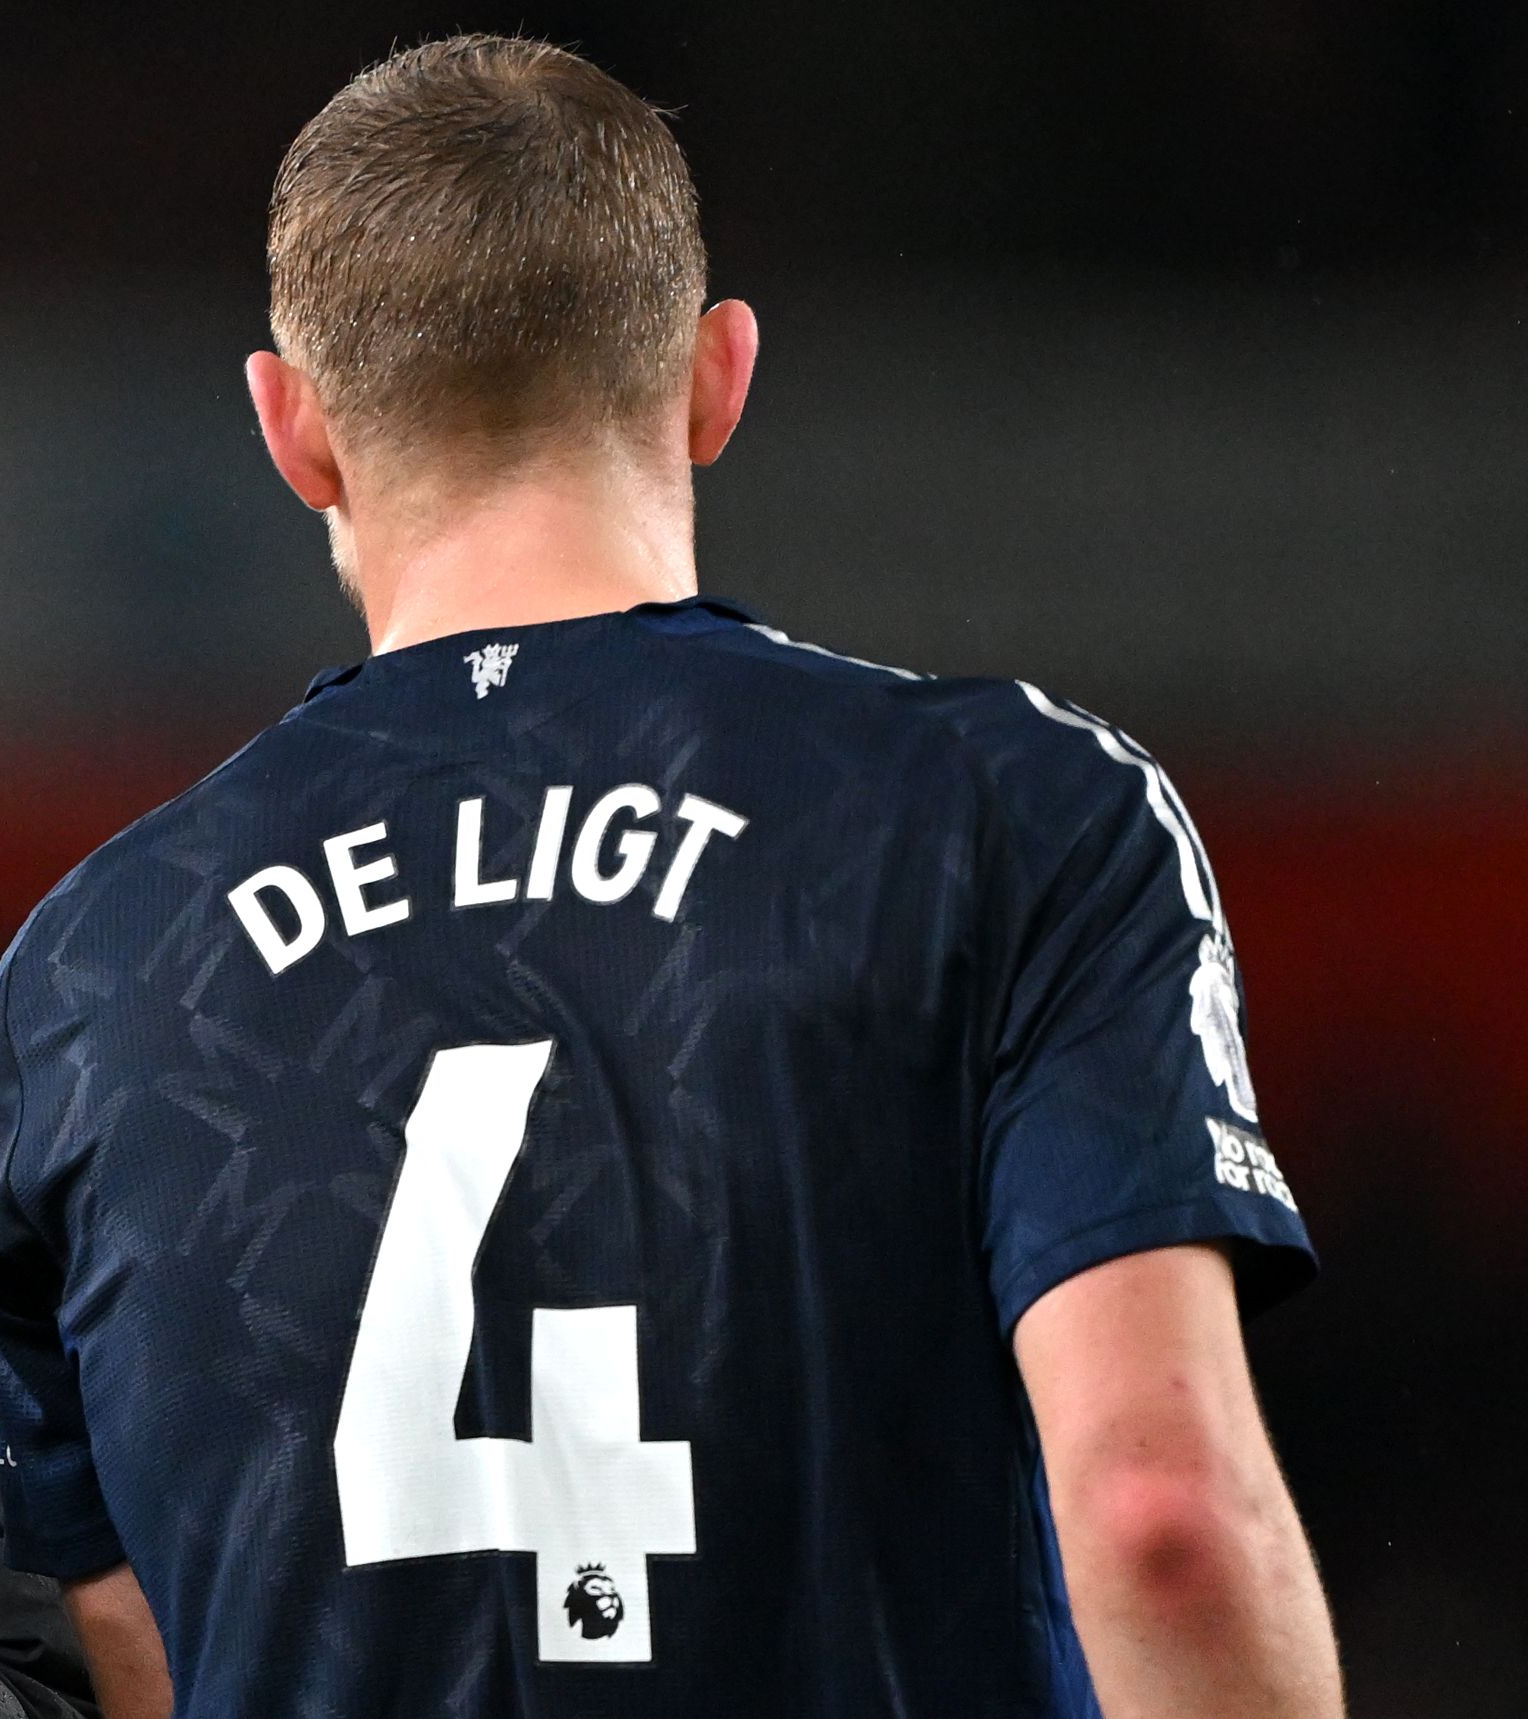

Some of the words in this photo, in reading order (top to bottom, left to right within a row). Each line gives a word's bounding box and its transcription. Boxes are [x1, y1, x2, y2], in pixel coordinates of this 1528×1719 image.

[227, 821, 411, 975] DE
[453, 783, 749, 923] LIGT
[333, 1039, 698, 1663] 4
